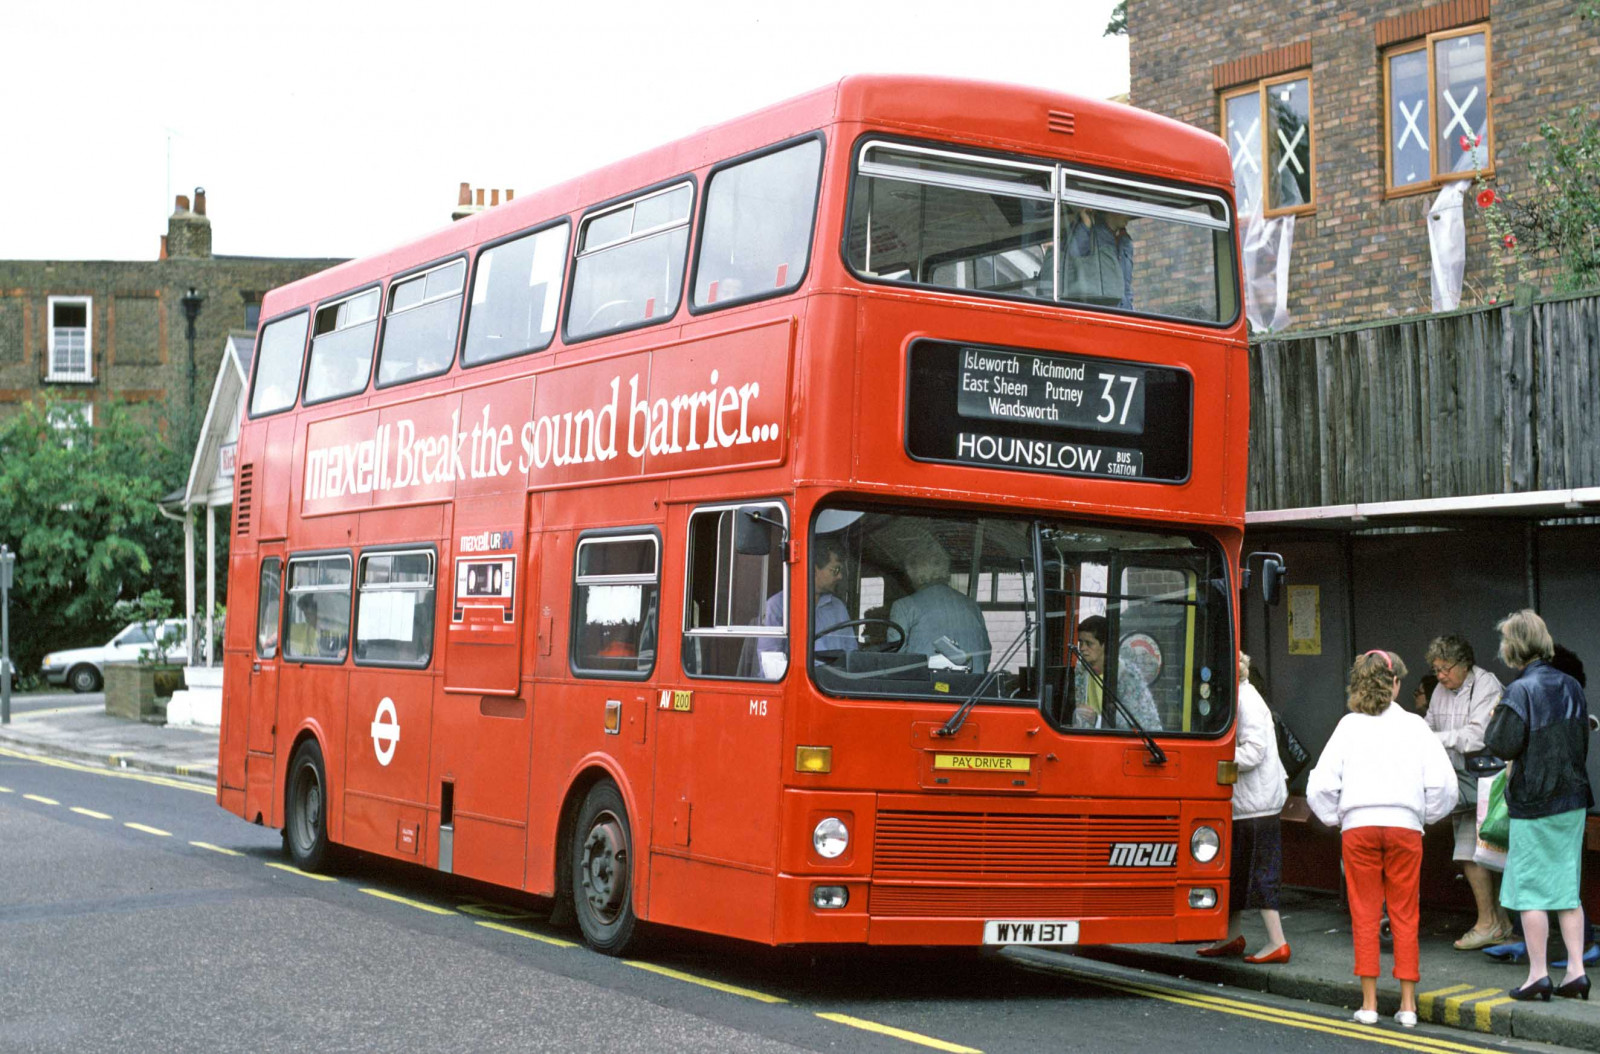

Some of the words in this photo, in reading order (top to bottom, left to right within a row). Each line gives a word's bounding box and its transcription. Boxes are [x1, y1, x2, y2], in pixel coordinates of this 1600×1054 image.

[964, 350, 1020, 375] Isleworth
[1032, 358, 1085, 382] Richmond
[962, 373, 989, 394] East
[993, 377, 1028, 398] Sheen
[1045, 382, 1084, 408] Putney
[1096, 373, 1138, 426] 37
[988, 396, 1059, 422] Wandsworth
[392, 407, 467, 489] Break
[470, 403, 514, 480] the
[518, 375, 621, 475] sound
[957, 432, 1102, 472] HOUNSLOW
[1116, 451, 1131, 464] BUS
[1107, 462, 1137, 477] STATION
[659, 690, 672, 709] AV
[675, 694, 690, 708] 200
[952, 756, 972, 767] PAY
[975, 757, 1012, 769] DRIVER
[998, 923, 1034, 942] WYW
[1038, 924, 1068, 942] 13T
